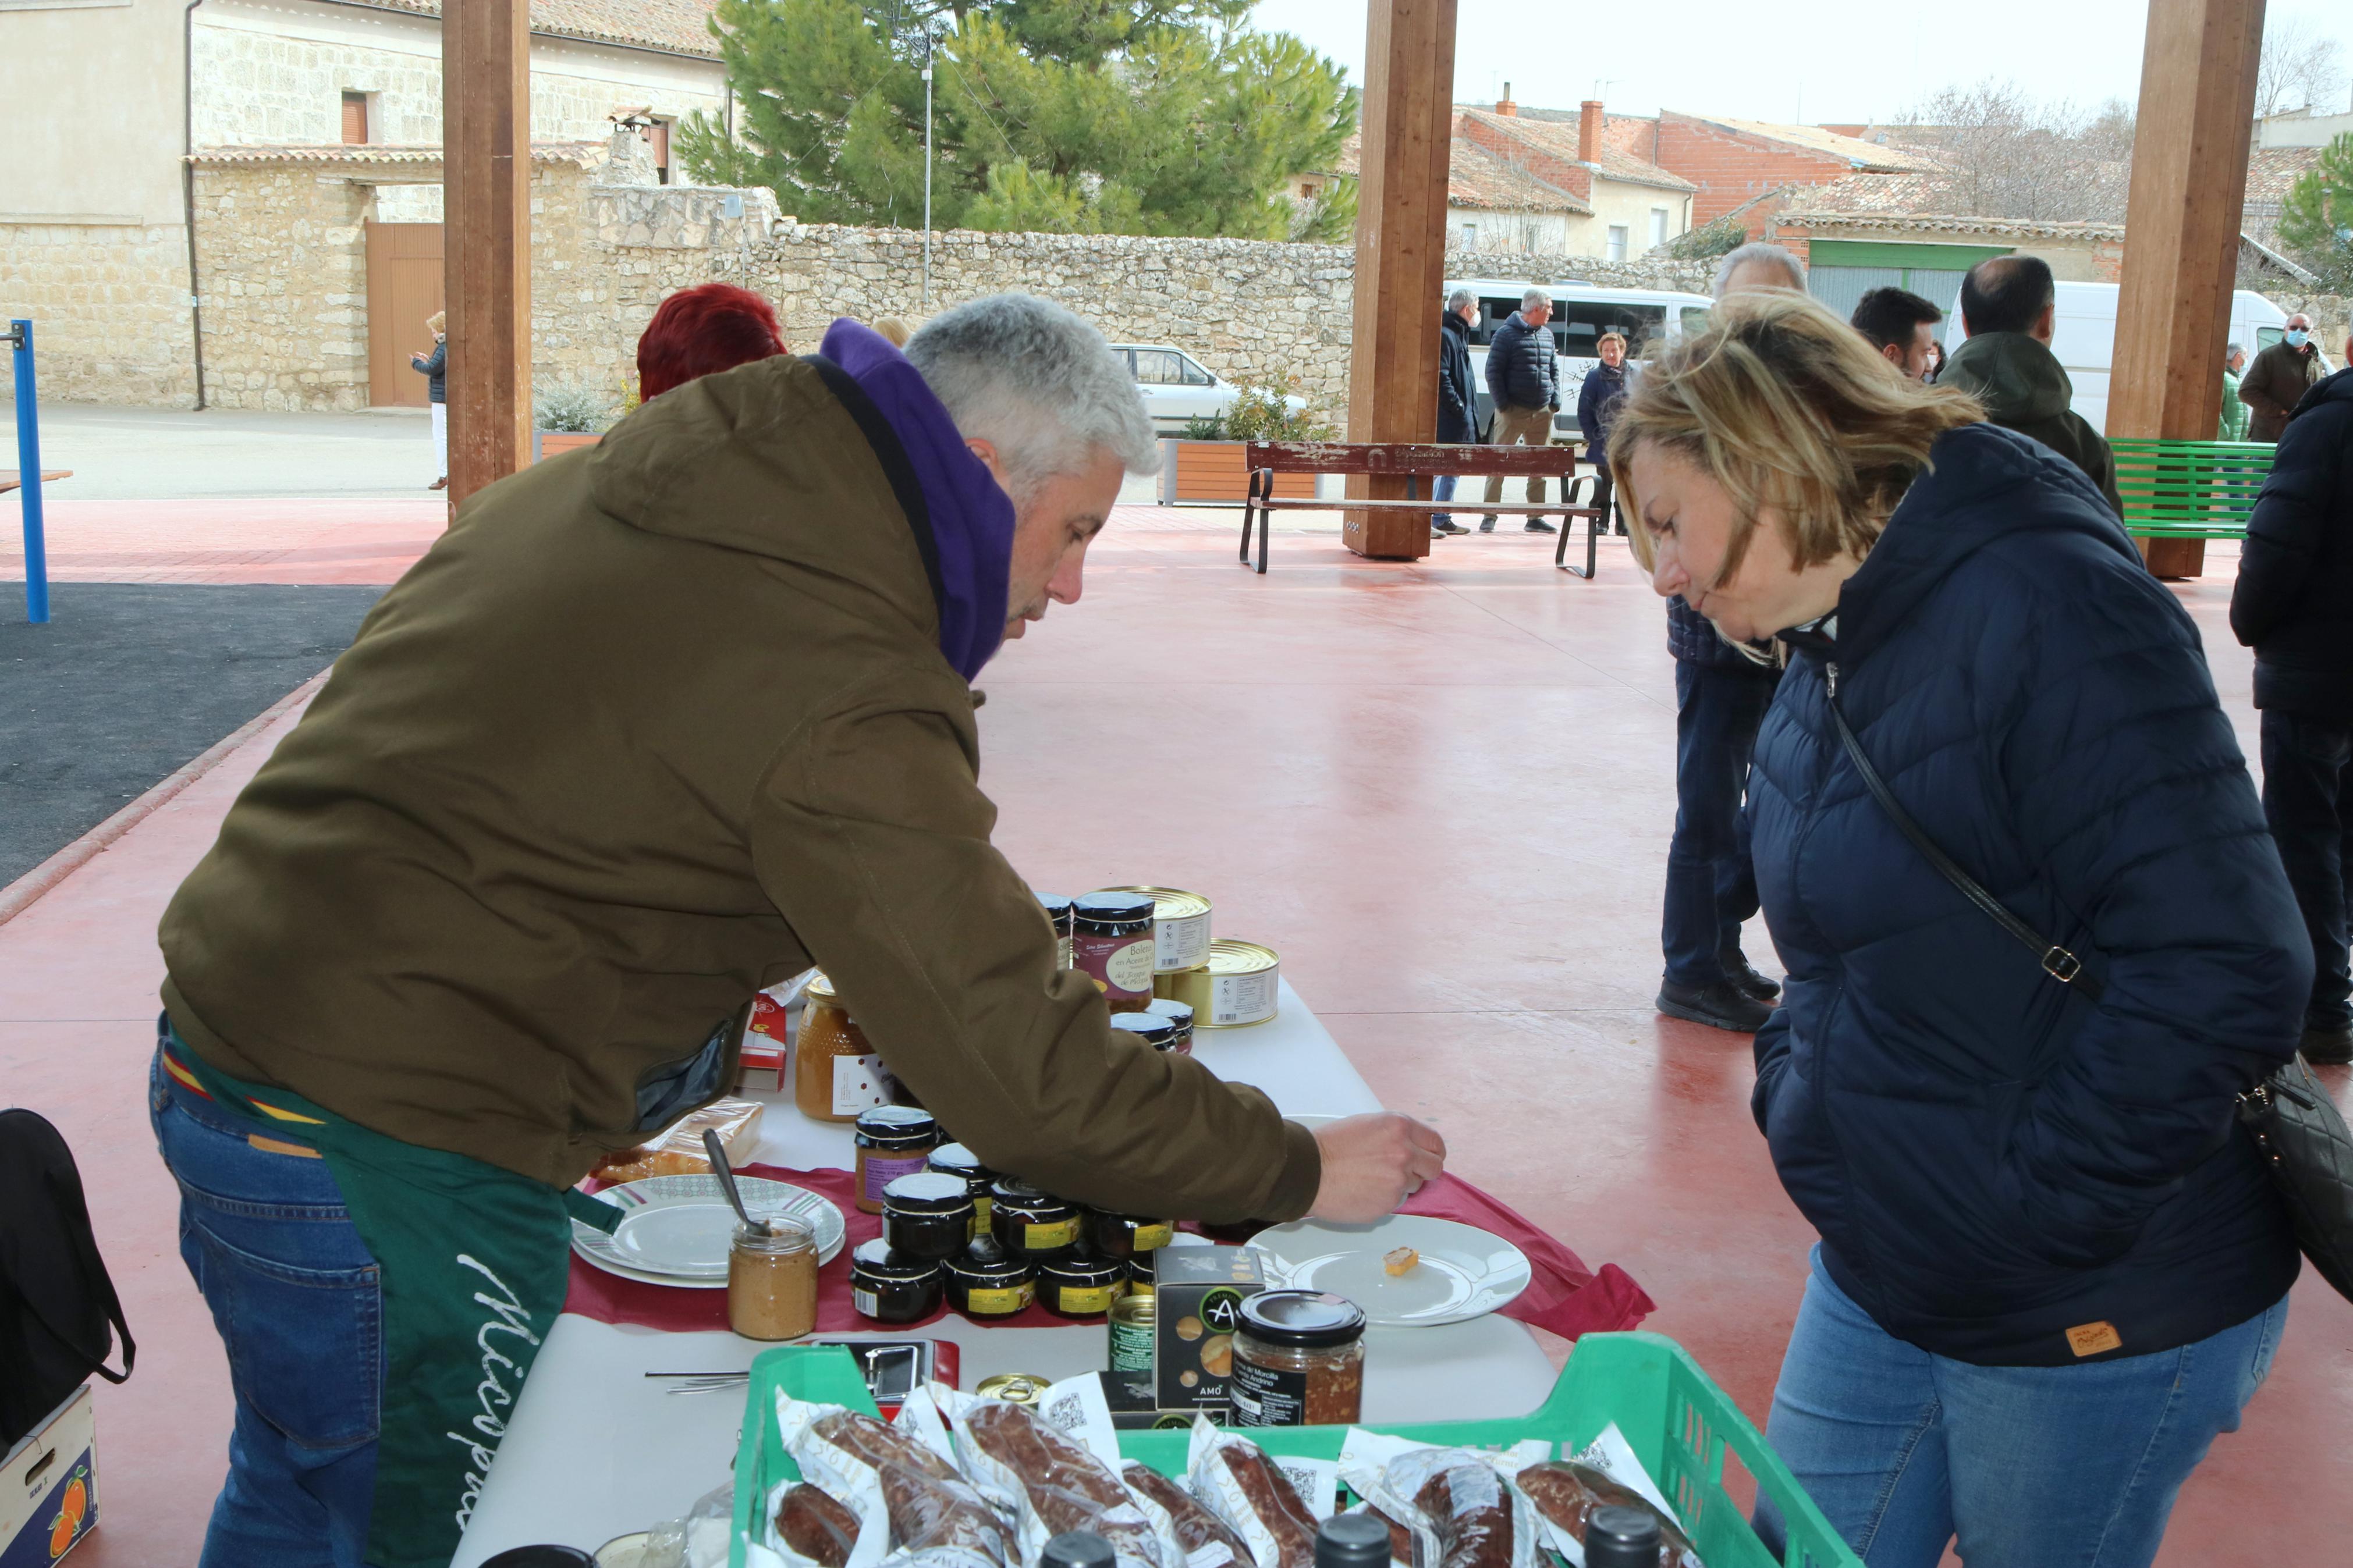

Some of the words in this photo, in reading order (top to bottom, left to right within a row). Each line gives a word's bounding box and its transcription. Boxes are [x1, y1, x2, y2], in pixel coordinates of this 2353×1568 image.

[1130, 943, 1152, 955] Boletus
[1250, 1374, 1274, 1386] Andrino
[1254, 1368, 1279, 1381] Morcilla
[1200, 1387, 1221, 1395] AMO
